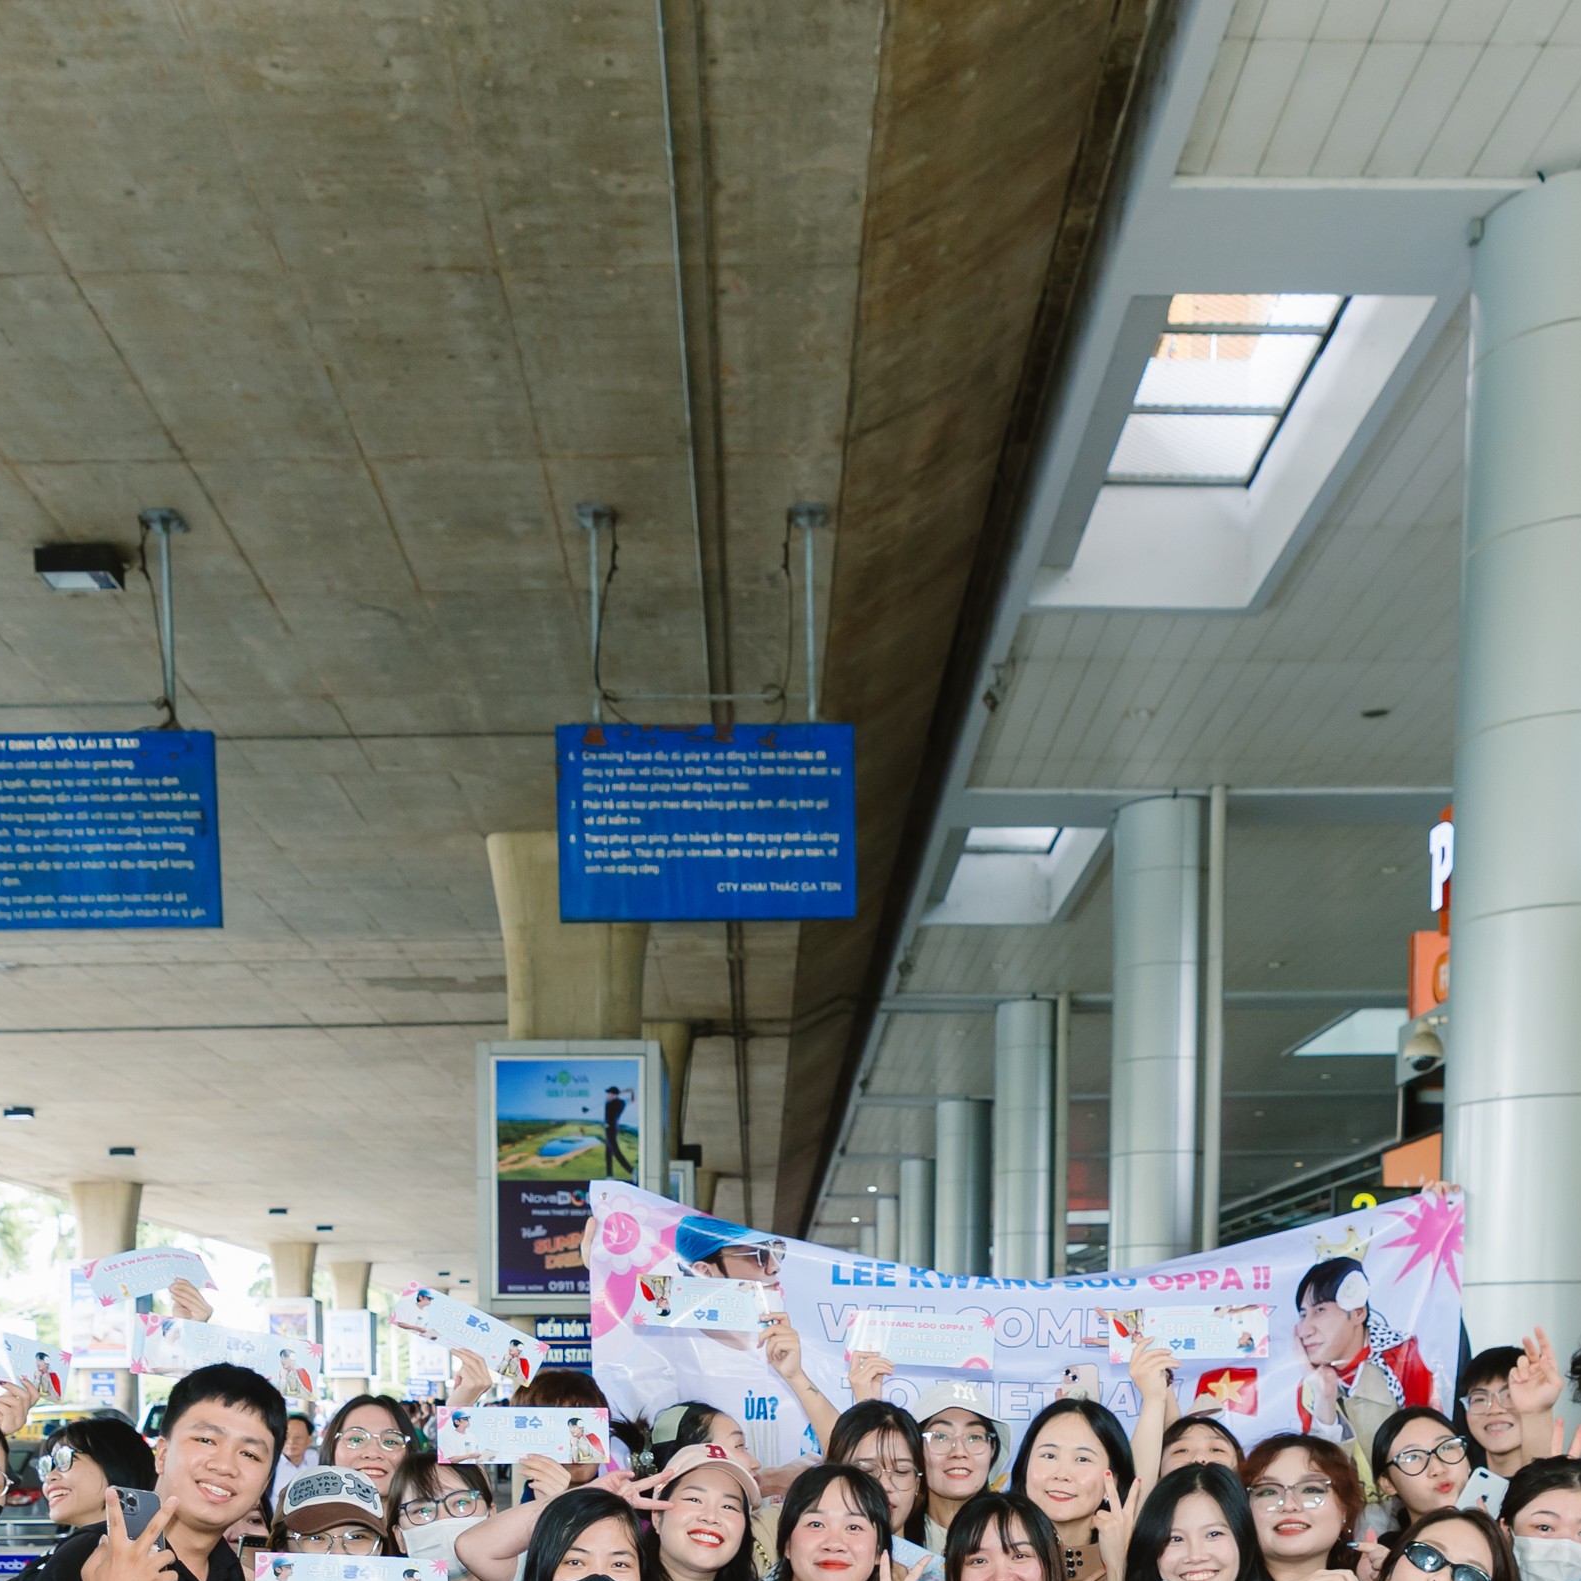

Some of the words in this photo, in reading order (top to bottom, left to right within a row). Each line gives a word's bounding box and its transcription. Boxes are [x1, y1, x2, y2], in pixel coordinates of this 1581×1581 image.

[831, 1260, 896, 1287] LEE
[1148, 1268, 1244, 1291] OPPA
[1253, 1266, 1271, 1291] !!
